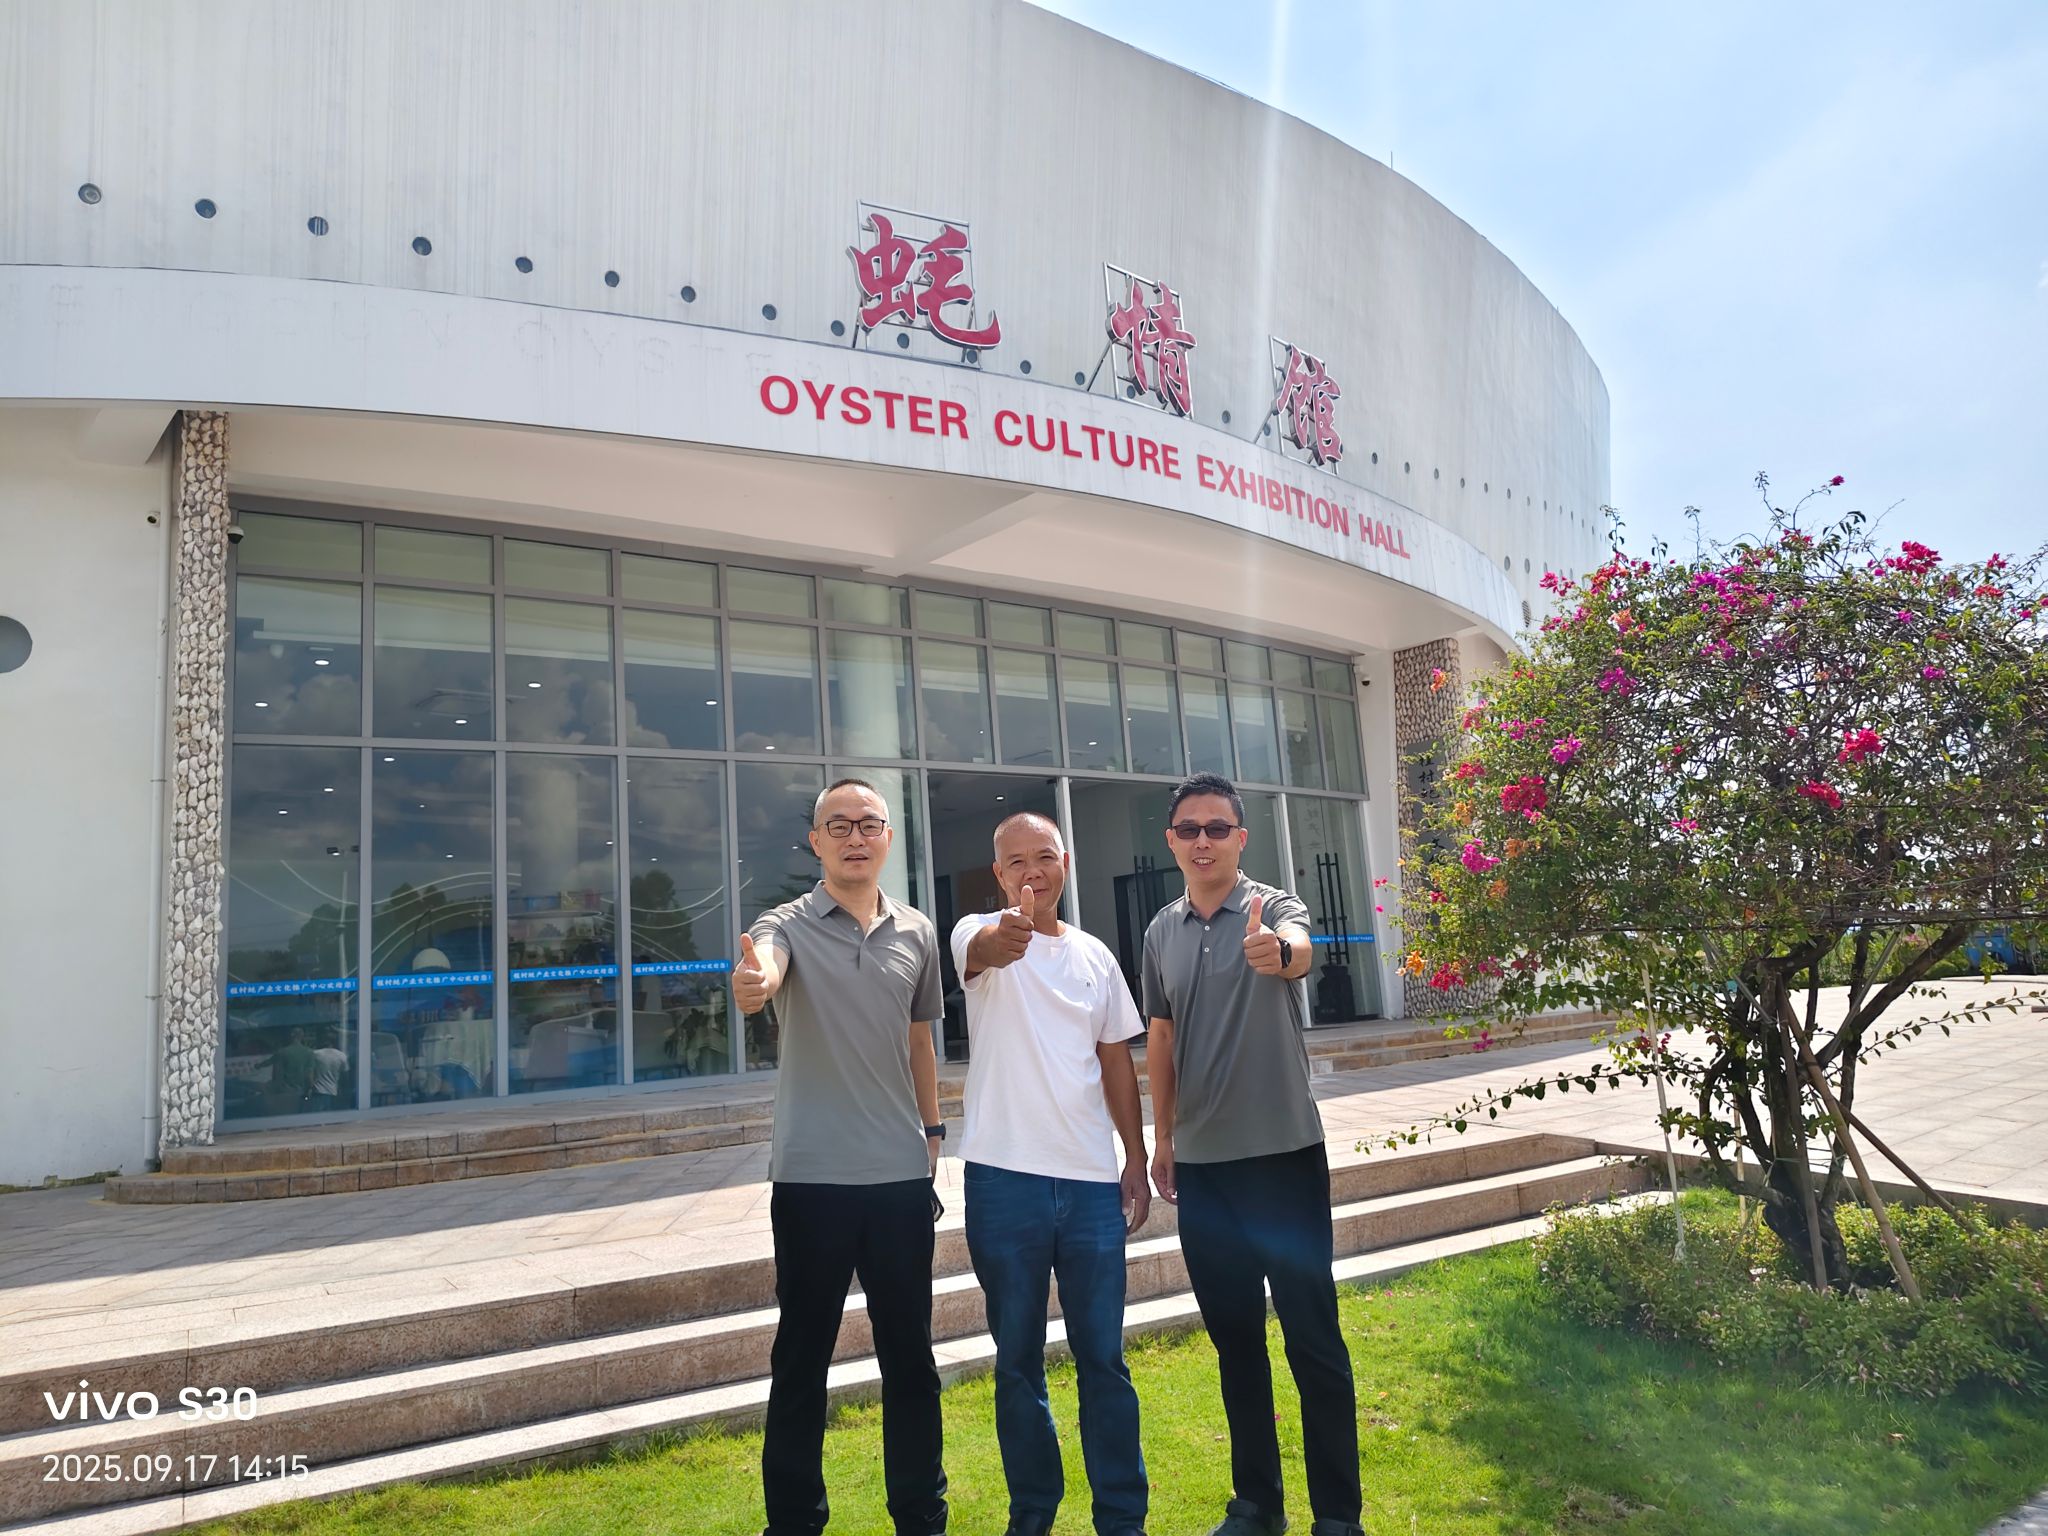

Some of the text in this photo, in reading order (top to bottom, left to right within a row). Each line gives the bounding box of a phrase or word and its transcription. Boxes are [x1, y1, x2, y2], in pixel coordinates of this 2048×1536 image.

[846, 212, 1343, 467] 蚝情馆
[760, 374, 1411, 561] OYSTER CULTURE EXHIBITION HALL
